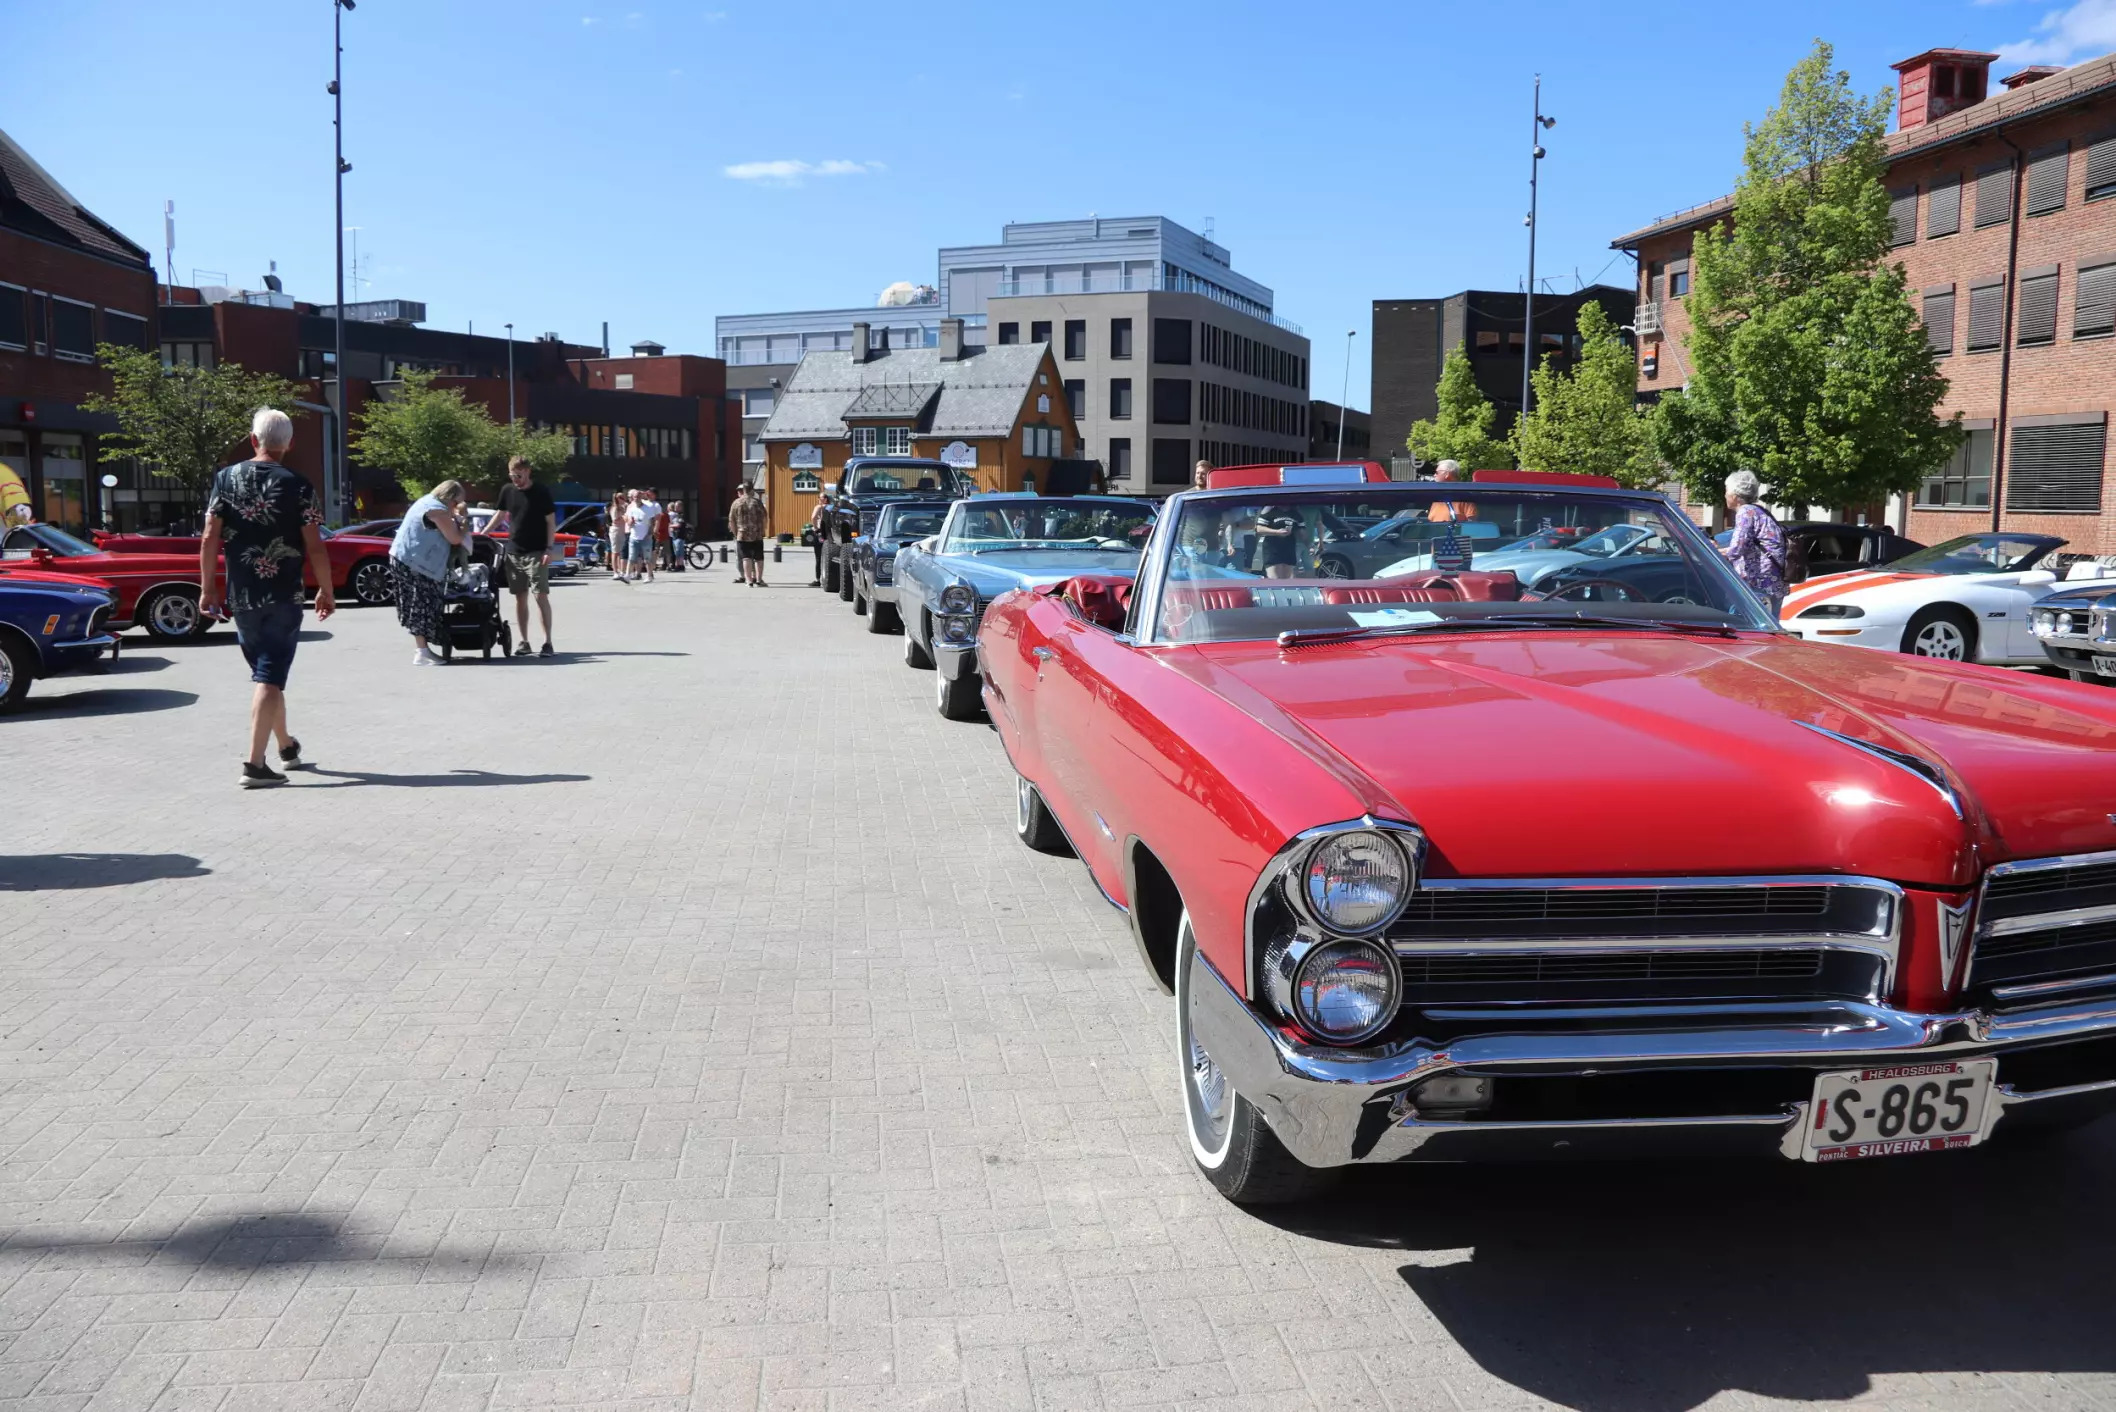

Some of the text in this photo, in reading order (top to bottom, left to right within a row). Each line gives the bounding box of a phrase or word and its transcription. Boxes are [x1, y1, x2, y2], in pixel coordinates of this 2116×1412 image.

[1869, 1064, 1951, 1080] HEALDSBURG
[1829, 1078, 1974, 1142] S-865
[1819, 1139, 1969, 1161] PONTIAC SILVEIRA BUICK
